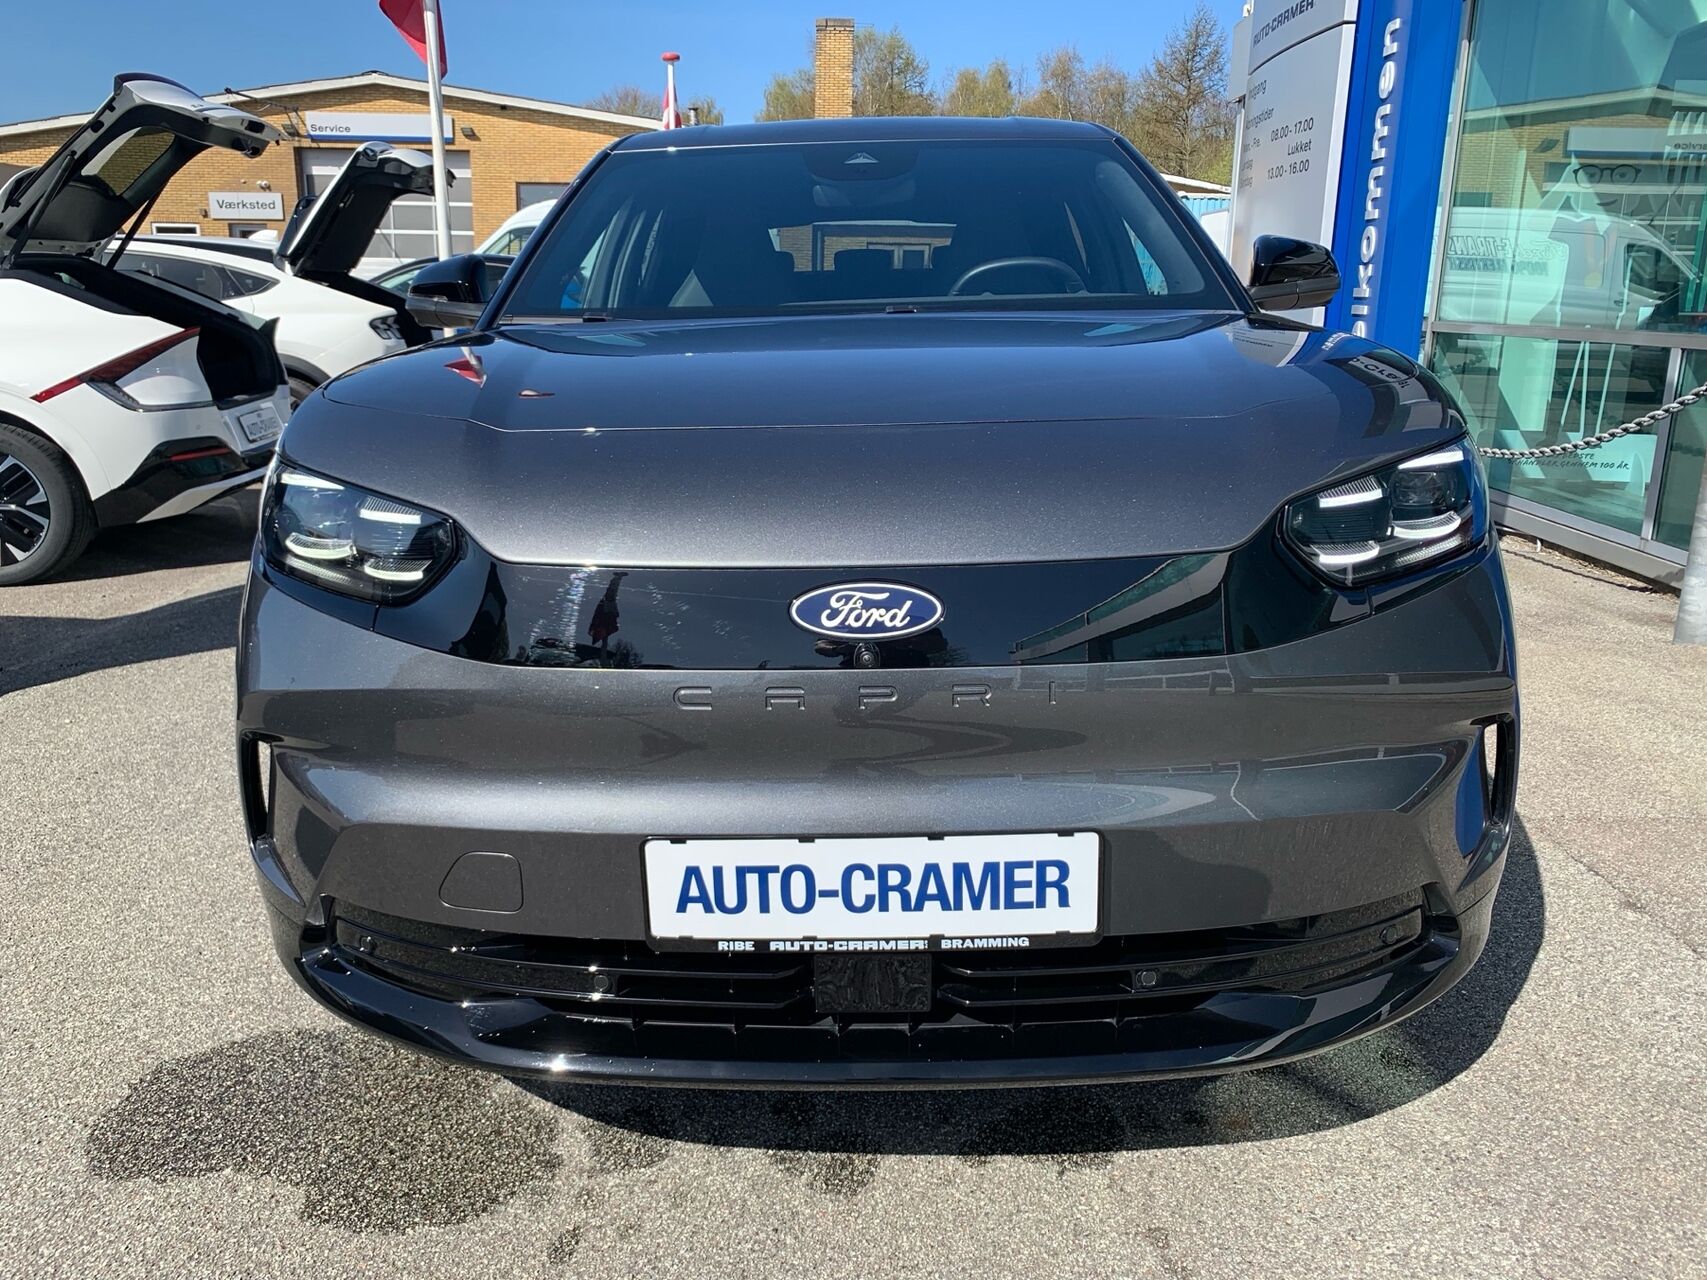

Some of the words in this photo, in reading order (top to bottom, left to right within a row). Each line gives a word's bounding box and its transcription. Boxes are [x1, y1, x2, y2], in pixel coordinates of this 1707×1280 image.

[310, 123, 351, 133] Service
[1294, 117, 1314, 135] 17.00
[1287, 139, 1312, 156] Lukket
[1288, 159, 1310, 175] 16.00
[216, 199, 276, 210] Værksted
[1599, 461, 1615, 469] 100
[1616, 459, 1631, 470] ÅR
[820, 590, 912, 628] Ford
[672, 681, 1056, 710] CAPRI
[676, 859, 1071, 914] AUTO-CRAMER
[718, 940, 755, 952] RIBE
[941, 937, 1030, 949] BRAMMING
